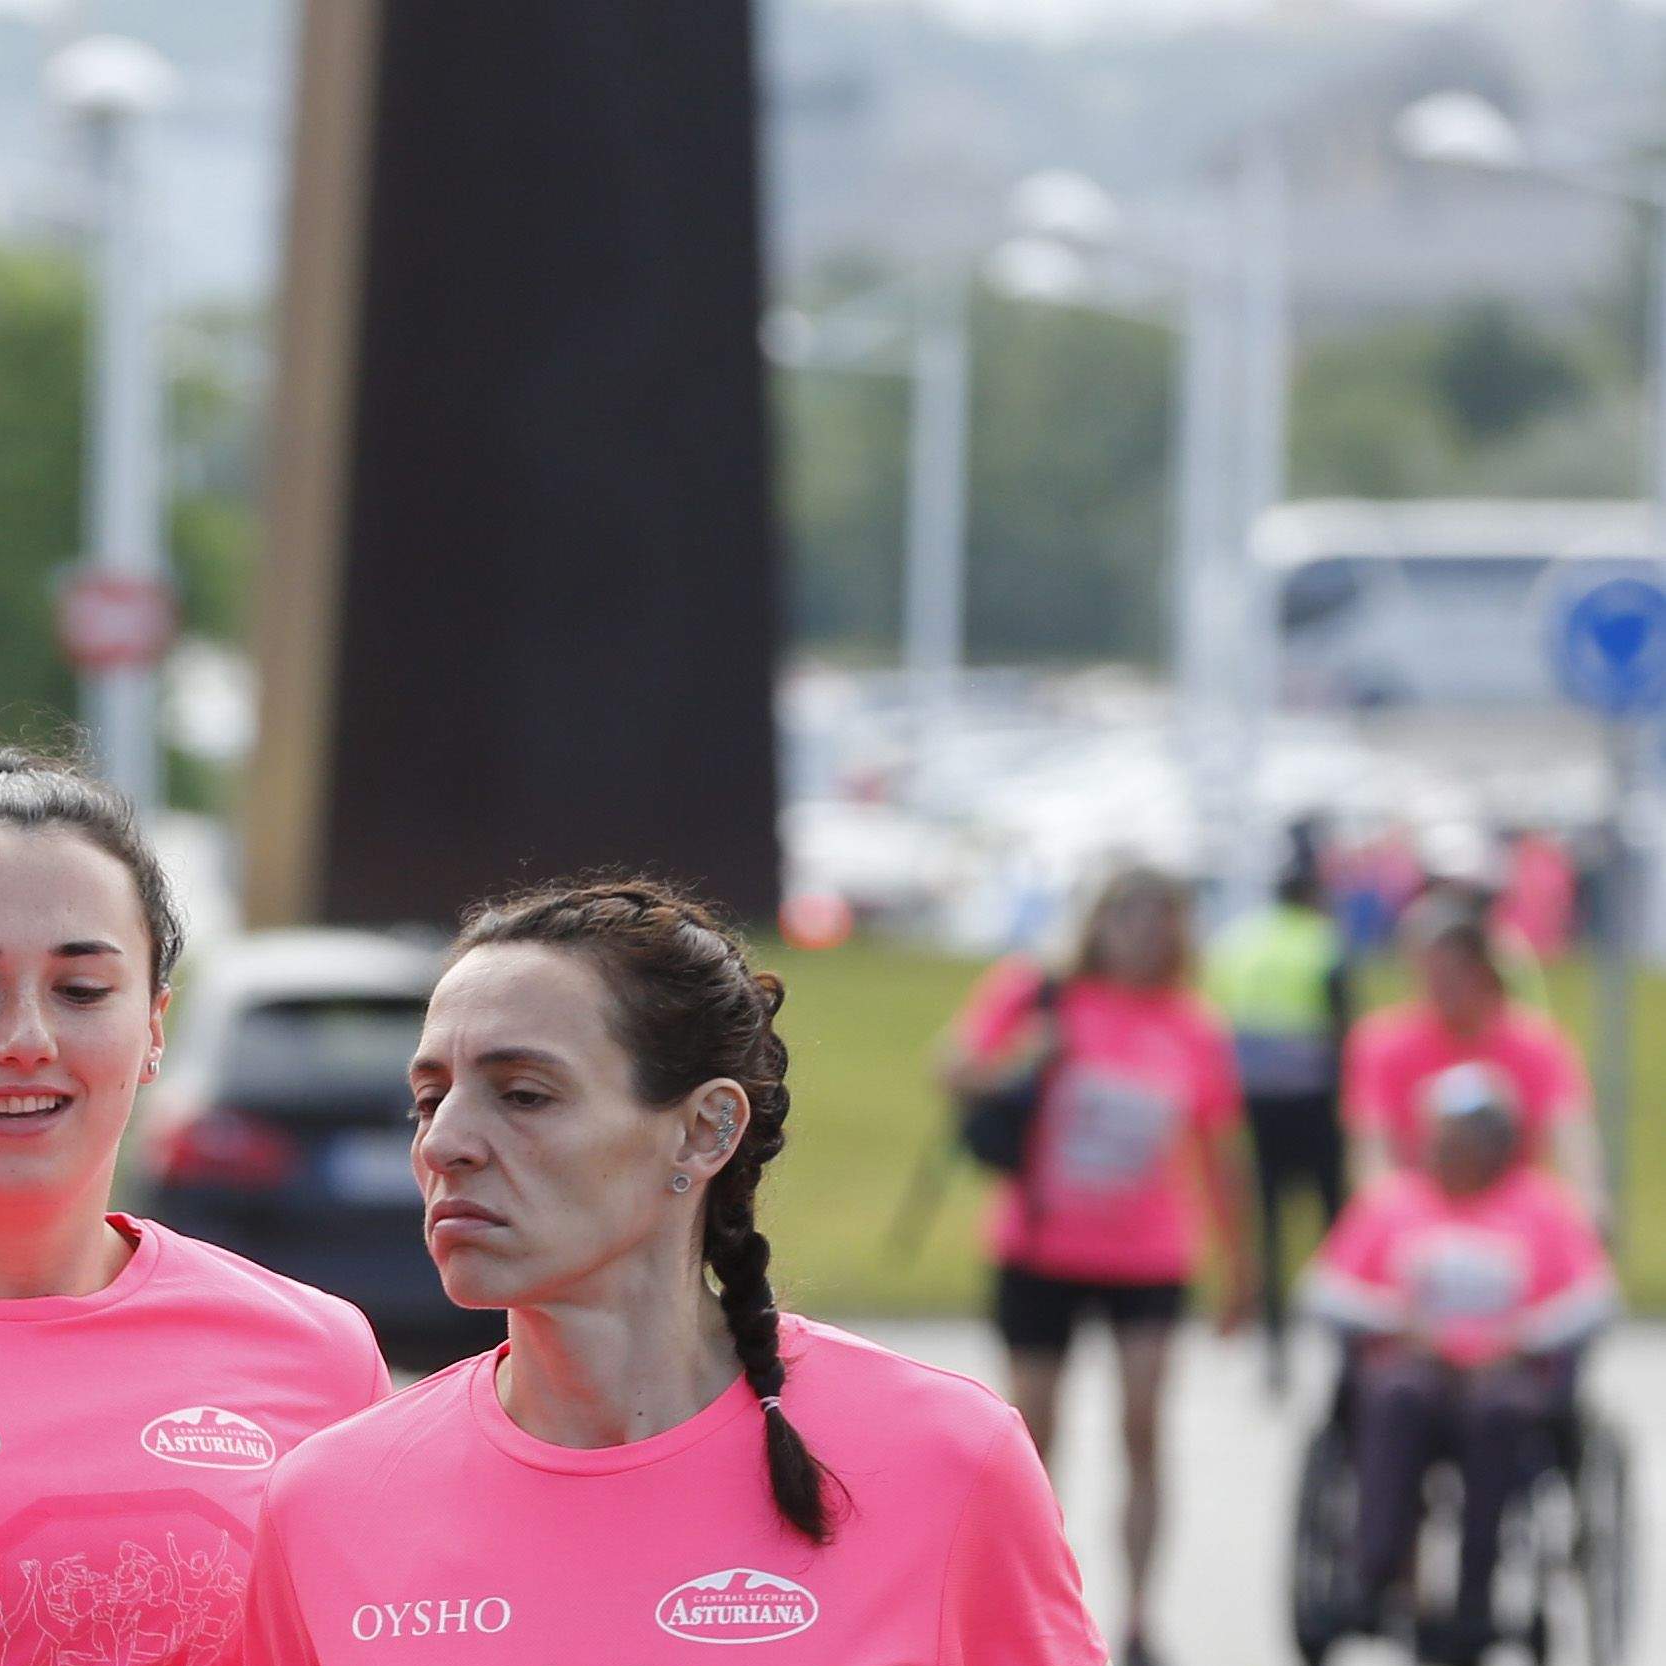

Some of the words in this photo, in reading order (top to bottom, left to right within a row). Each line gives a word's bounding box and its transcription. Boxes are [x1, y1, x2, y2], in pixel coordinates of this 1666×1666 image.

[155, 1428, 268, 1461] ASTURIANA
[352, 1597, 511, 1641] OYSHO
[668, 1598, 804, 1625] ASTURIANA
